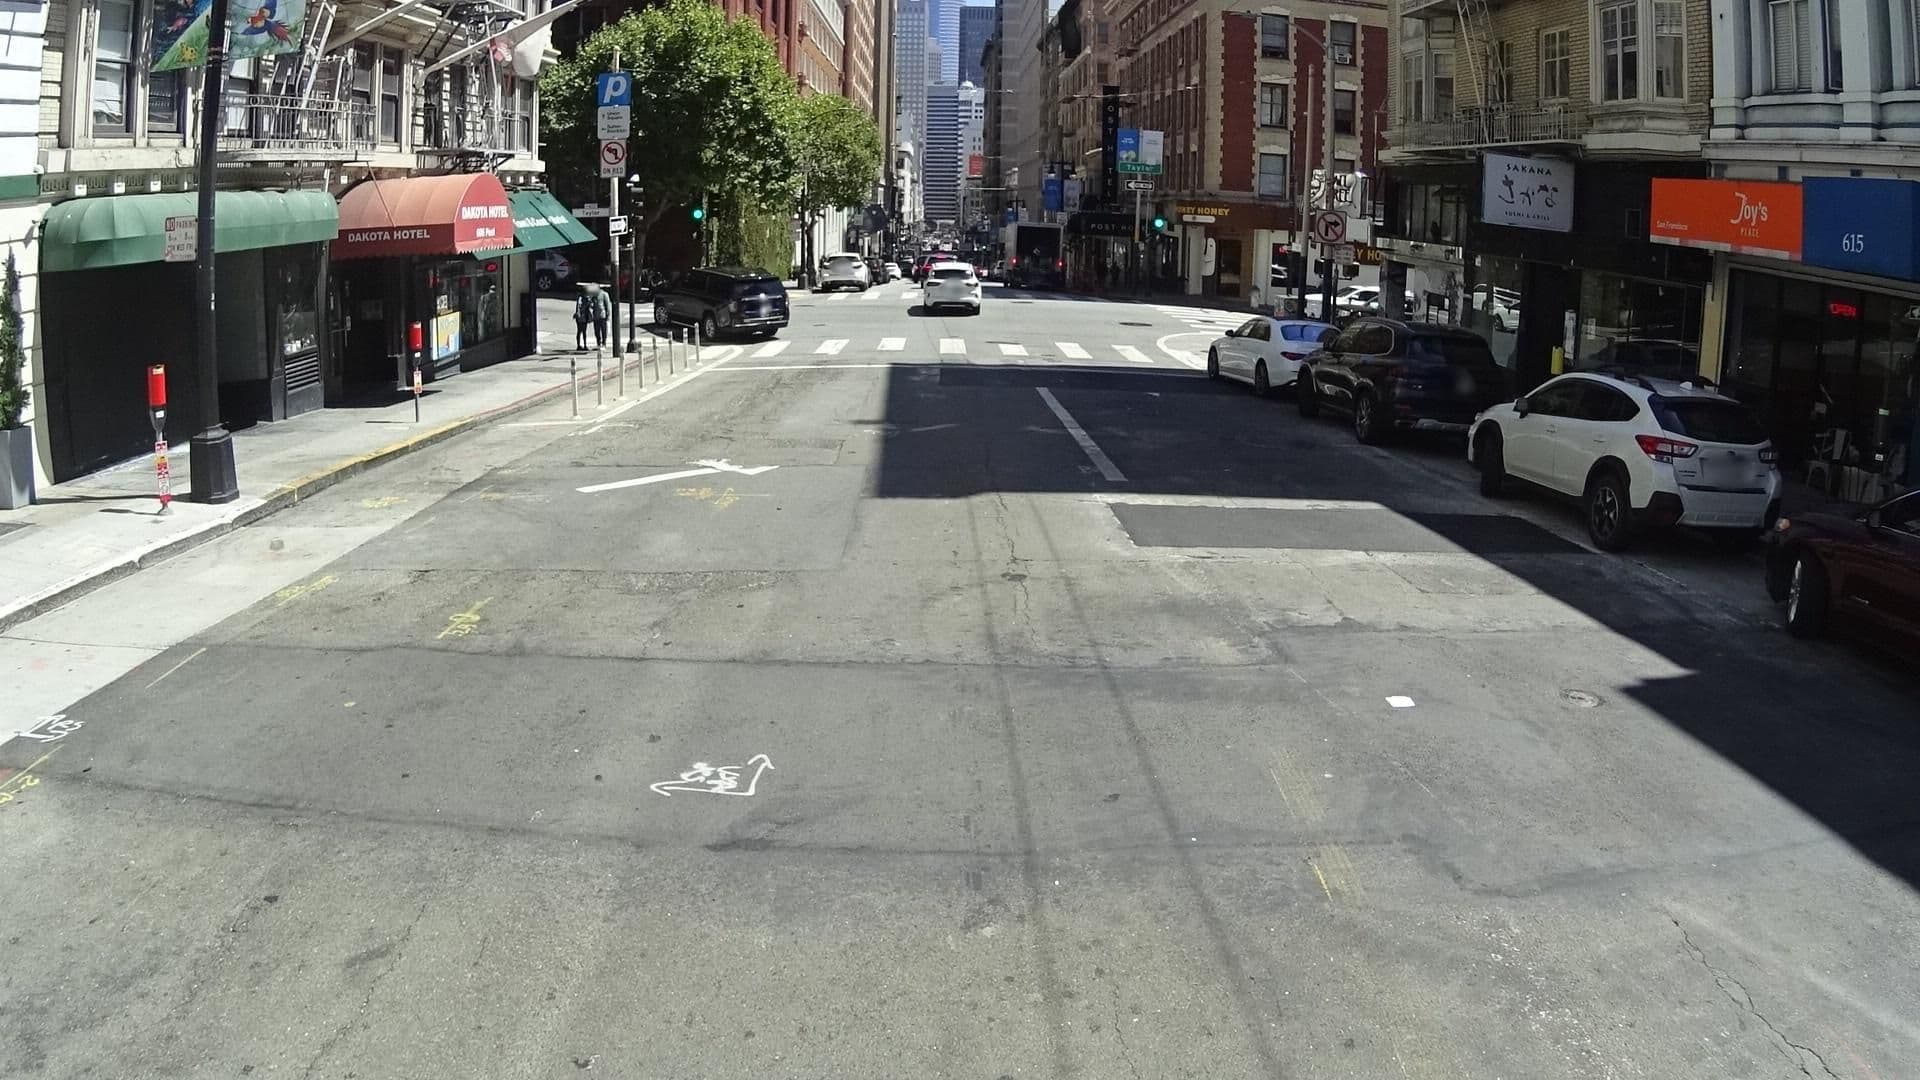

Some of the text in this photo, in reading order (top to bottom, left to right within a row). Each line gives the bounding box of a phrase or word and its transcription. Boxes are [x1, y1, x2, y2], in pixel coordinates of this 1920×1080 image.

[603, 75, 627, 104] P
[611, 166, 624, 174] RED
[1506, 163, 1552, 176] SAKANA
[461, 204, 509, 220] DAKOTA HOTEL
[1197, 206, 1231, 216] HONEY
[1730, 191, 1769, 226] Joy's
[1090, 223, 1116, 232] POST
[1740, 227, 1760, 238] PLACE
[348, 228, 431, 242] DAKOTA HOTEL
[1842, 232, 1864, 253] 615
